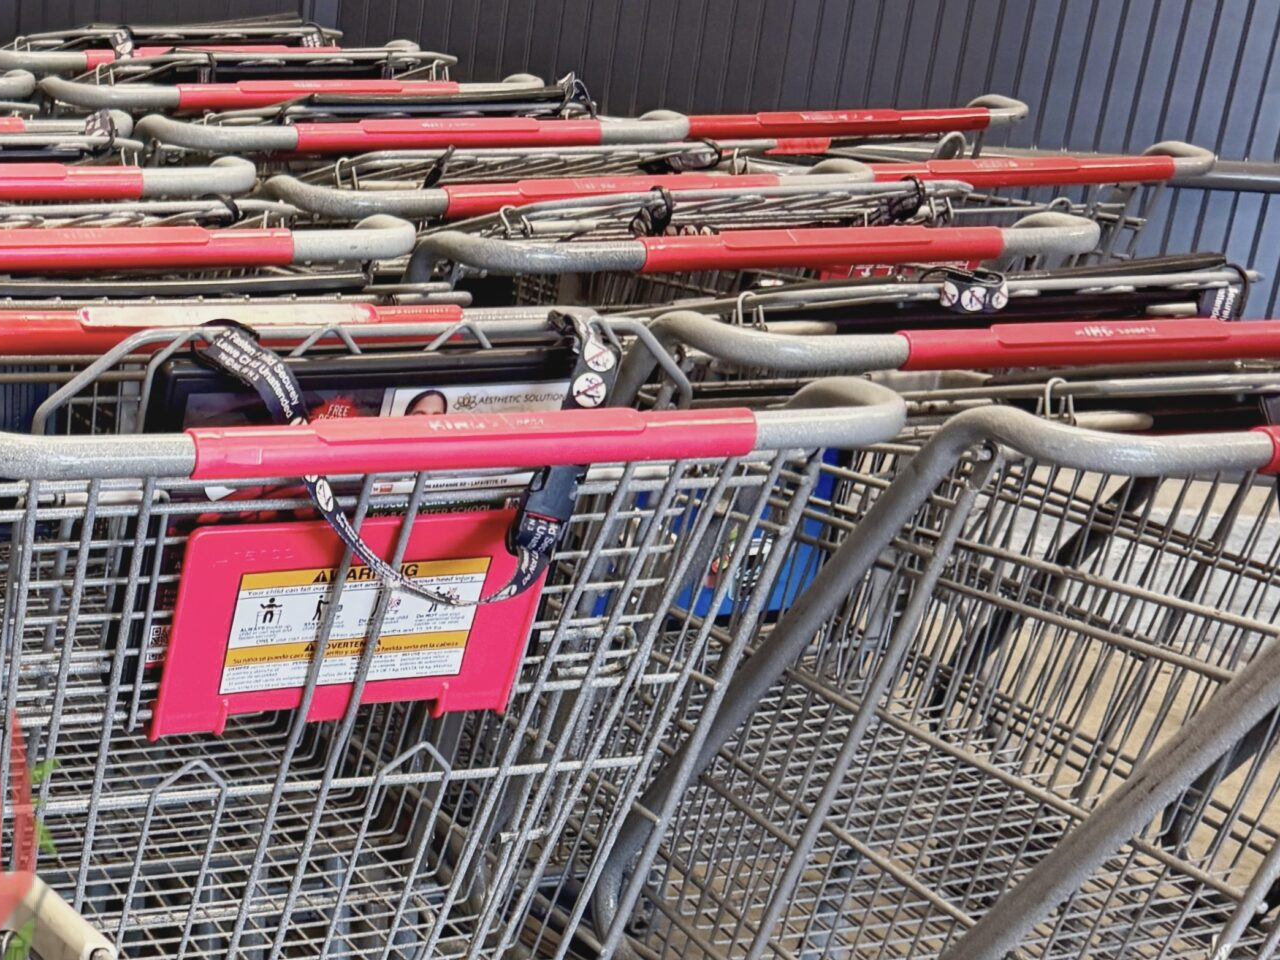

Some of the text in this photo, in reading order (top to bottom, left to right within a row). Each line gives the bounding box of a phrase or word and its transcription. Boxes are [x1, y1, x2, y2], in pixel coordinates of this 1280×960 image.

[274, 362, 300, 406] Securely
[478, 394, 521, 405] AESTHETIC
[327, 404, 351, 417] FREE
